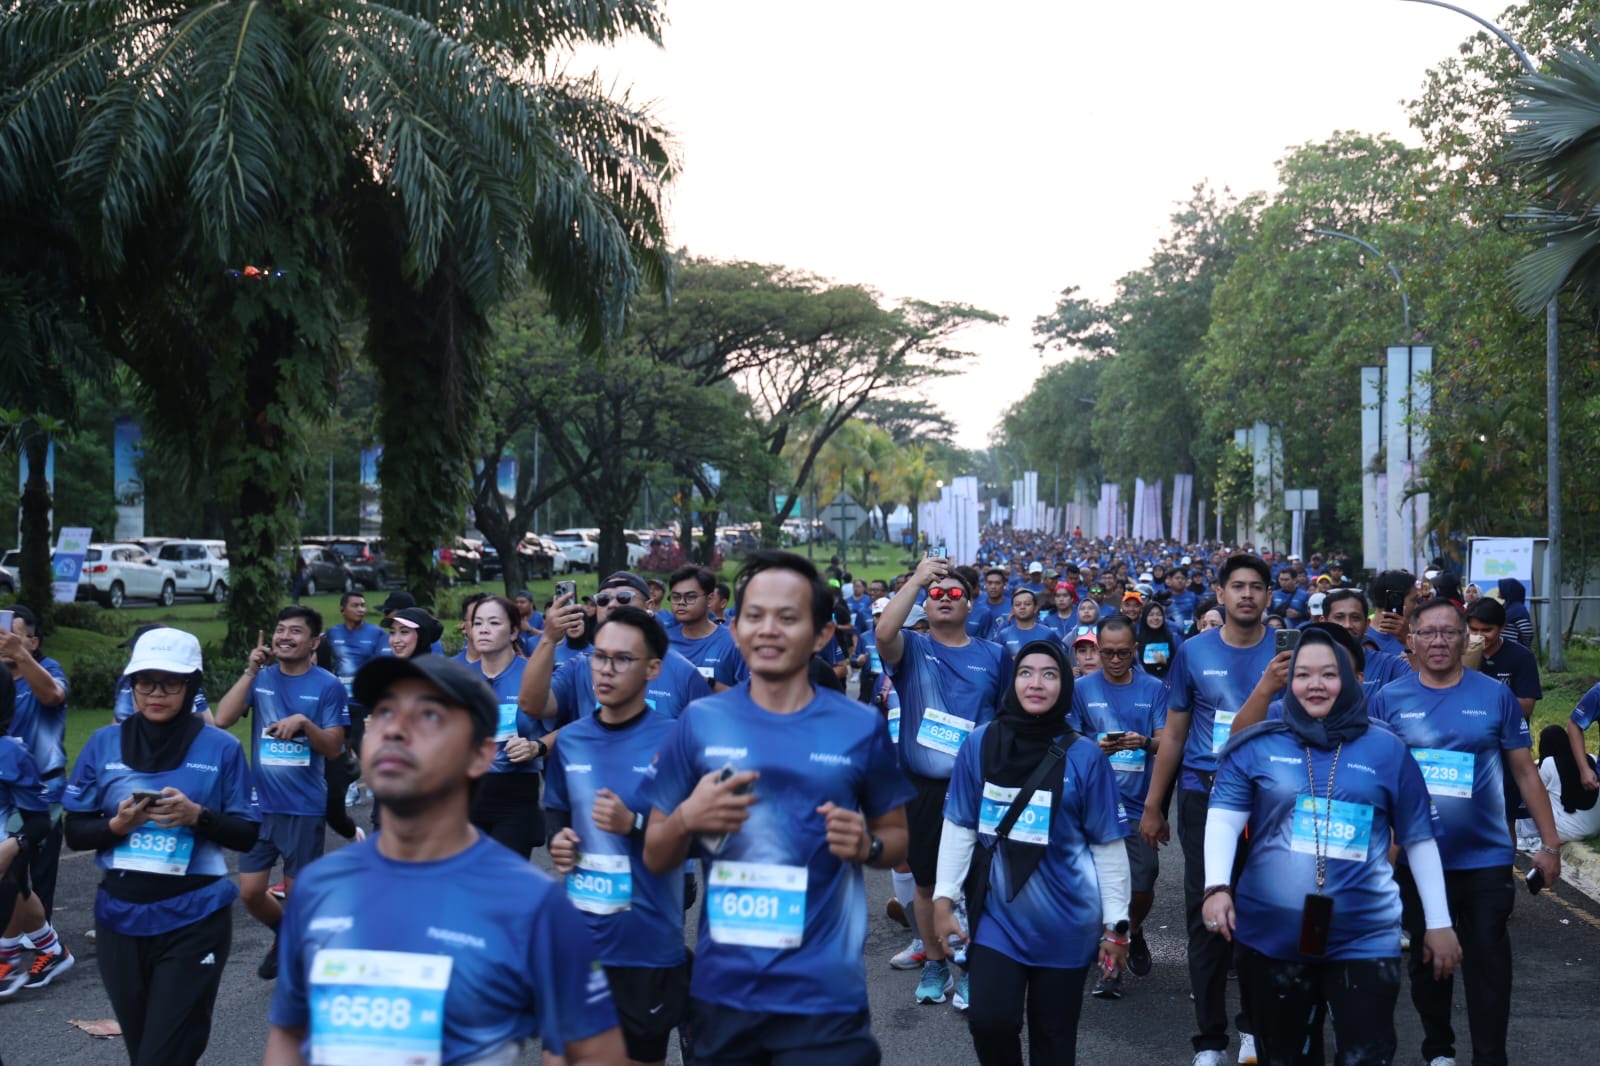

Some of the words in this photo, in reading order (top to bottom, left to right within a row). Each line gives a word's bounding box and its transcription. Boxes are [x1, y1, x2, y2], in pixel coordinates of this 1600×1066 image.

[930, 725, 961, 742] 6296
[270, 742, 303, 753] 6300
[1422, 766, 1458, 780] 7239
[994, 805, 1036, 825] 70
[1312, 818, 1356, 840] 7238
[129, 832, 178, 853] 6338
[574, 875, 613, 894] 6401
[722, 892, 780, 920] 6081
[330, 994, 412, 1031] 6588
